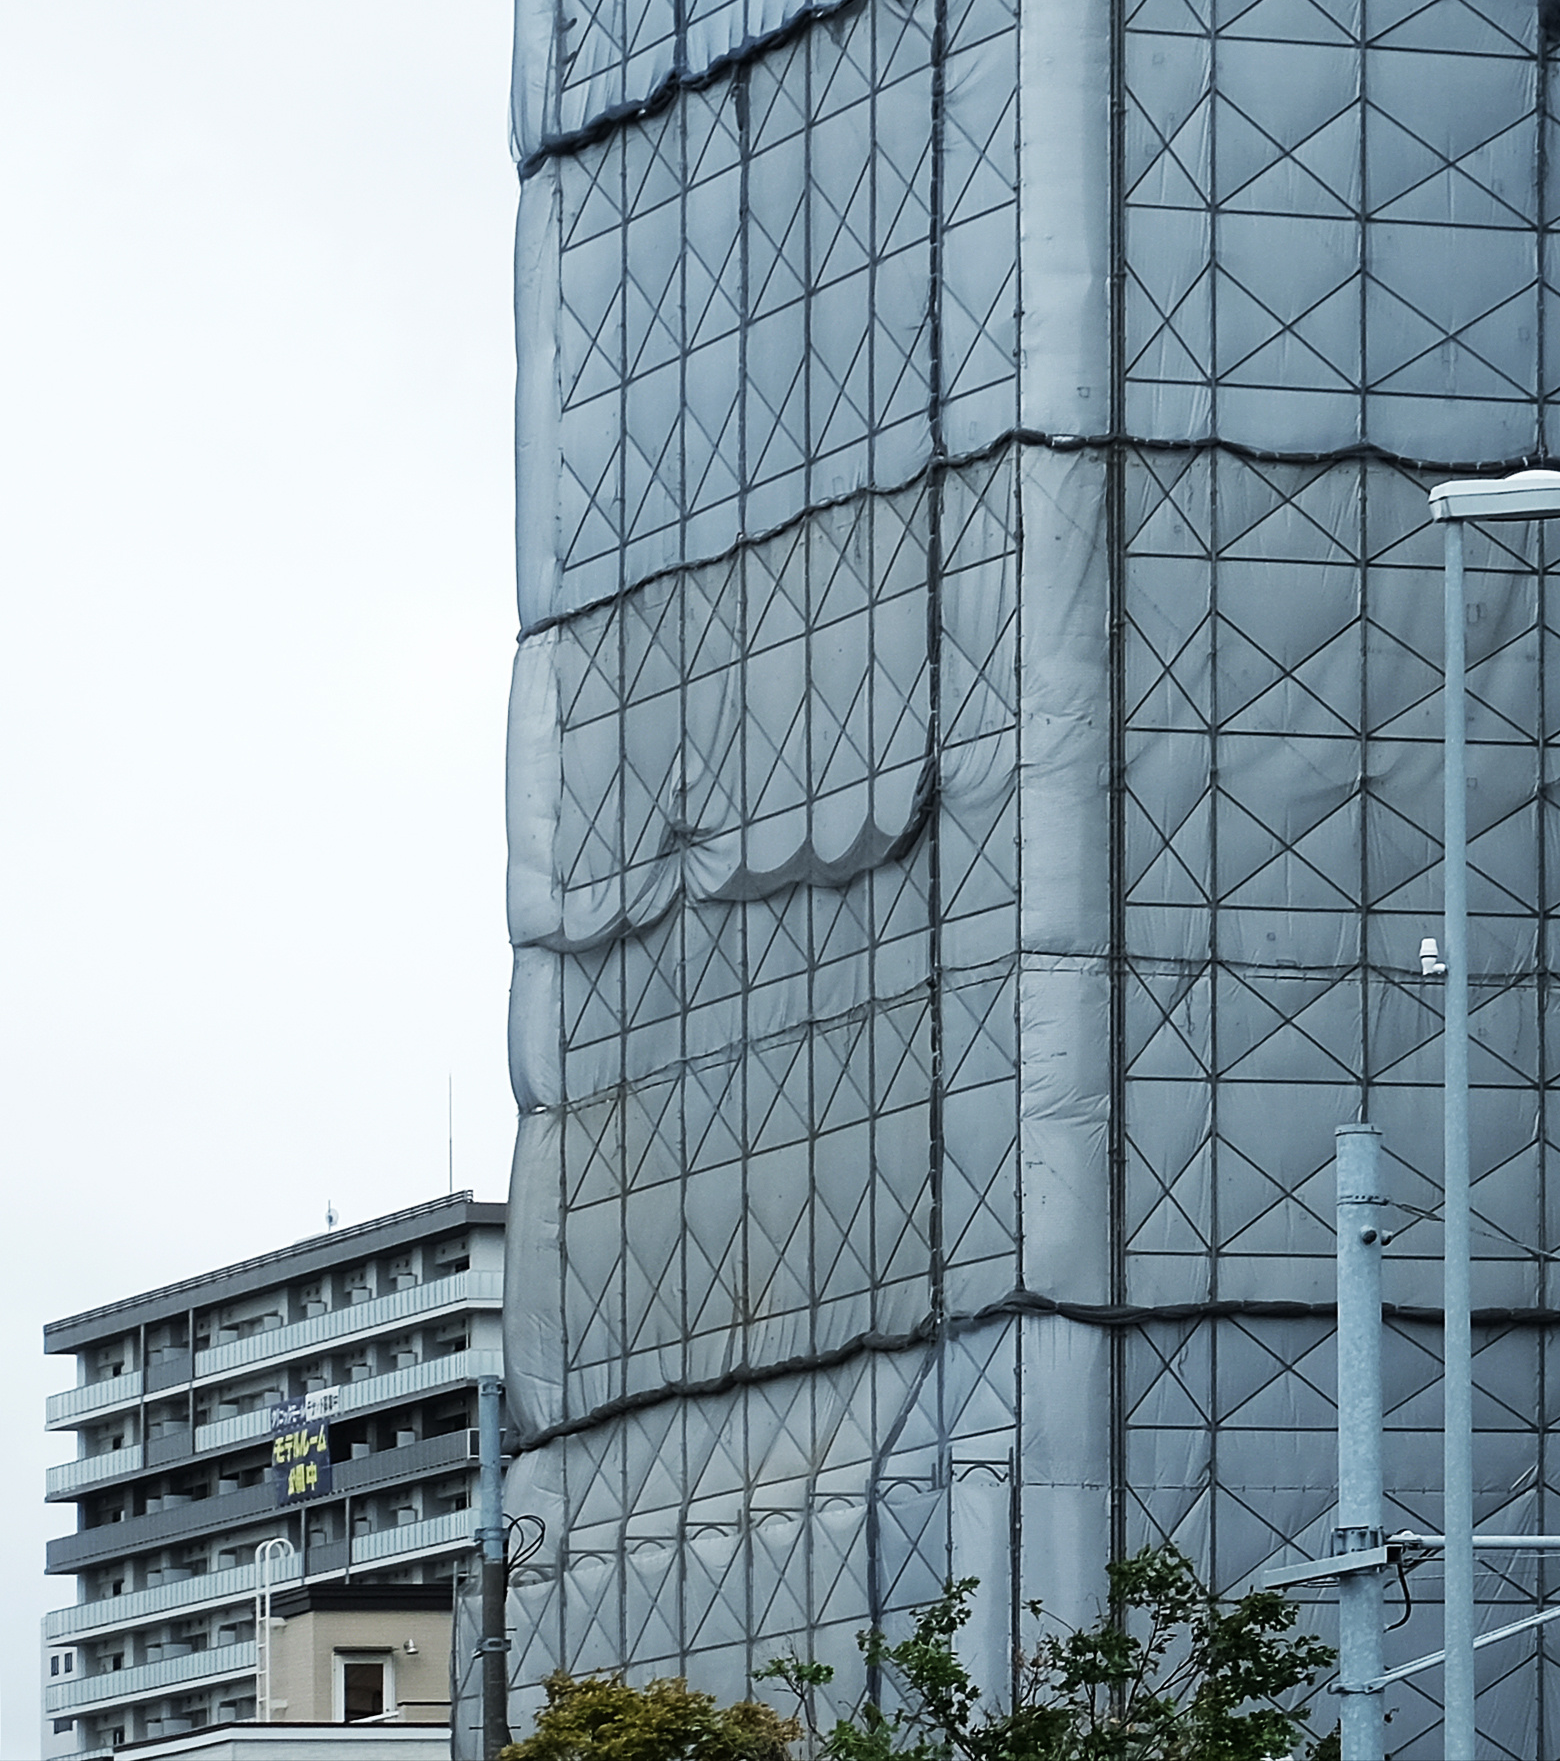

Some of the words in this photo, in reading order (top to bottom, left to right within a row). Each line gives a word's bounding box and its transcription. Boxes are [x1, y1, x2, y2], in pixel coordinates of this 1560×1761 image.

[273, 1424, 327, 1463] モデルルーム
